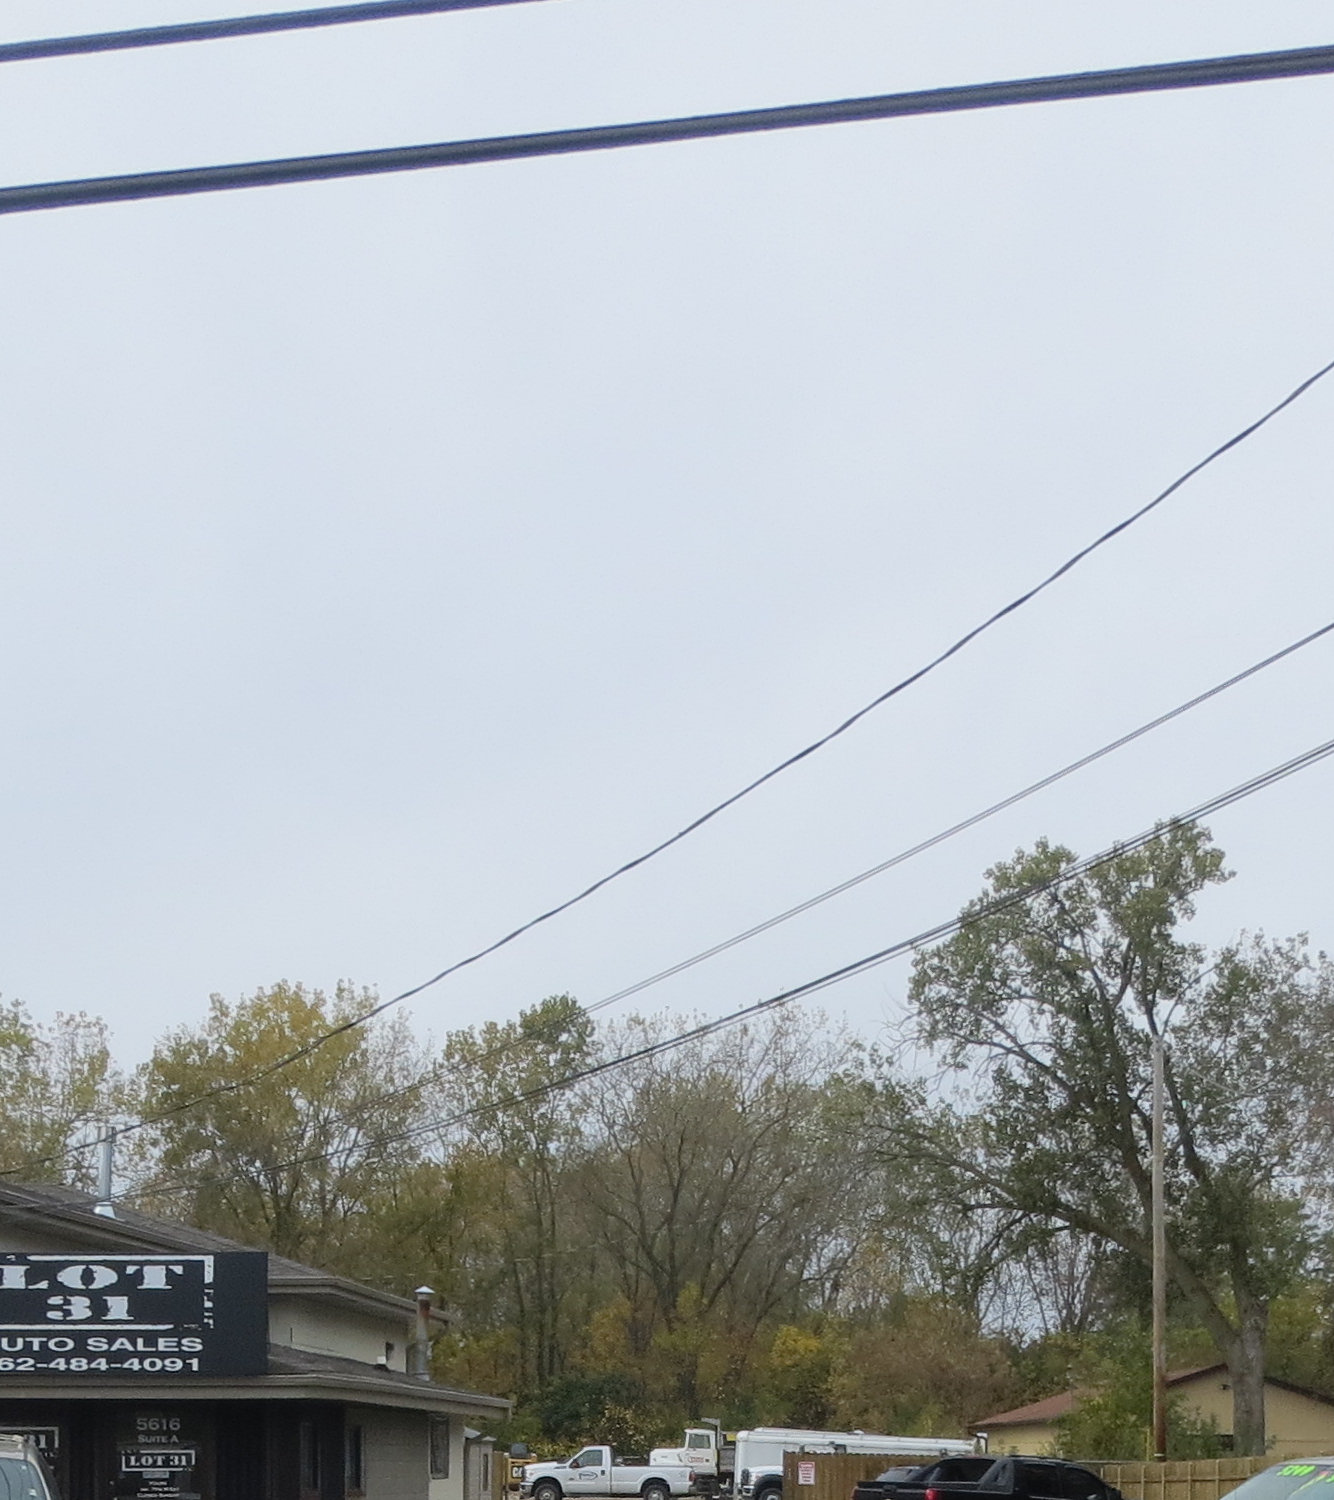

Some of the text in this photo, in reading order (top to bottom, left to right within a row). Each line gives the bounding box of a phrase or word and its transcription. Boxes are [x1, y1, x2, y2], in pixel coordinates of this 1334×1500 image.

[46, 1296, 135, 1321] 31
[86, 1337, 204, 1352] SALES
[136, 1418, 181, 1431] 5616
[129, 1455, 187, 1467] LOT 31
